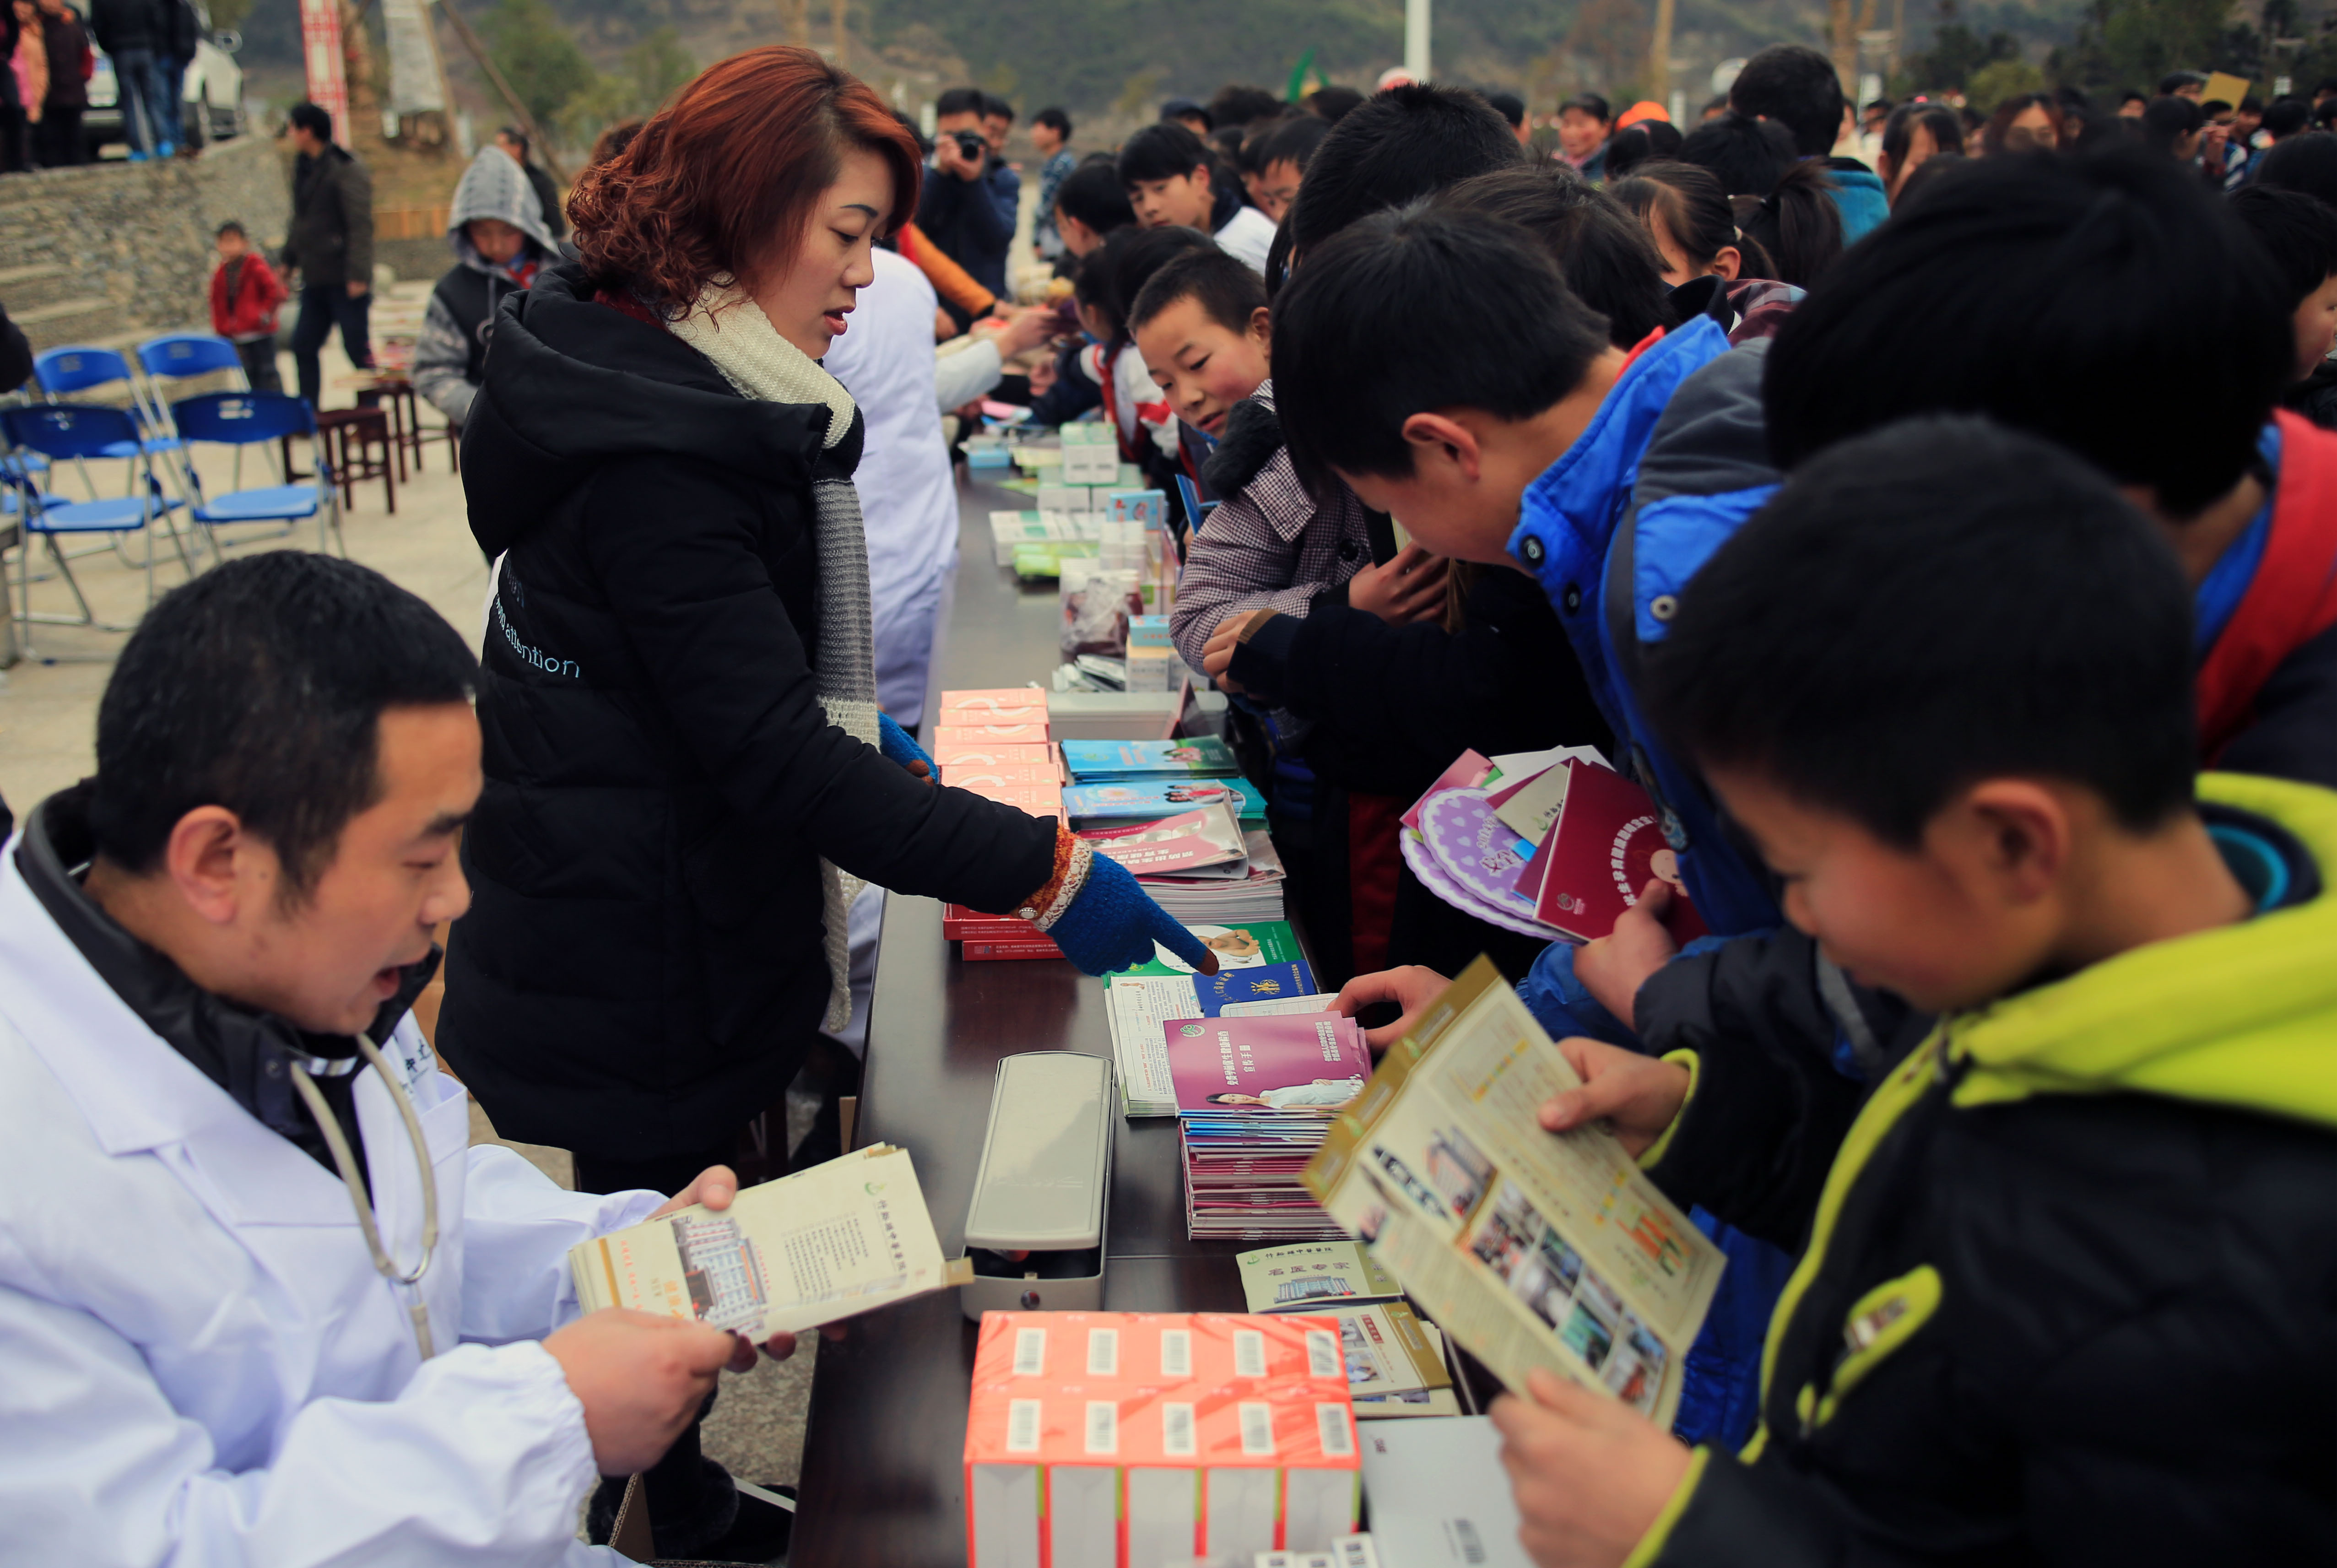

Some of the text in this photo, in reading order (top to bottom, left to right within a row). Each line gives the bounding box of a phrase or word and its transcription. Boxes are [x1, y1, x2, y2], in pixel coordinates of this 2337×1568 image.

[1217, 1030, 1239, 1086] 免费孕前优生健康检查
[1239, 1044, 1255, 1073] 宣传手册
[1268, 1261, 1350, 1276] 名医专家
